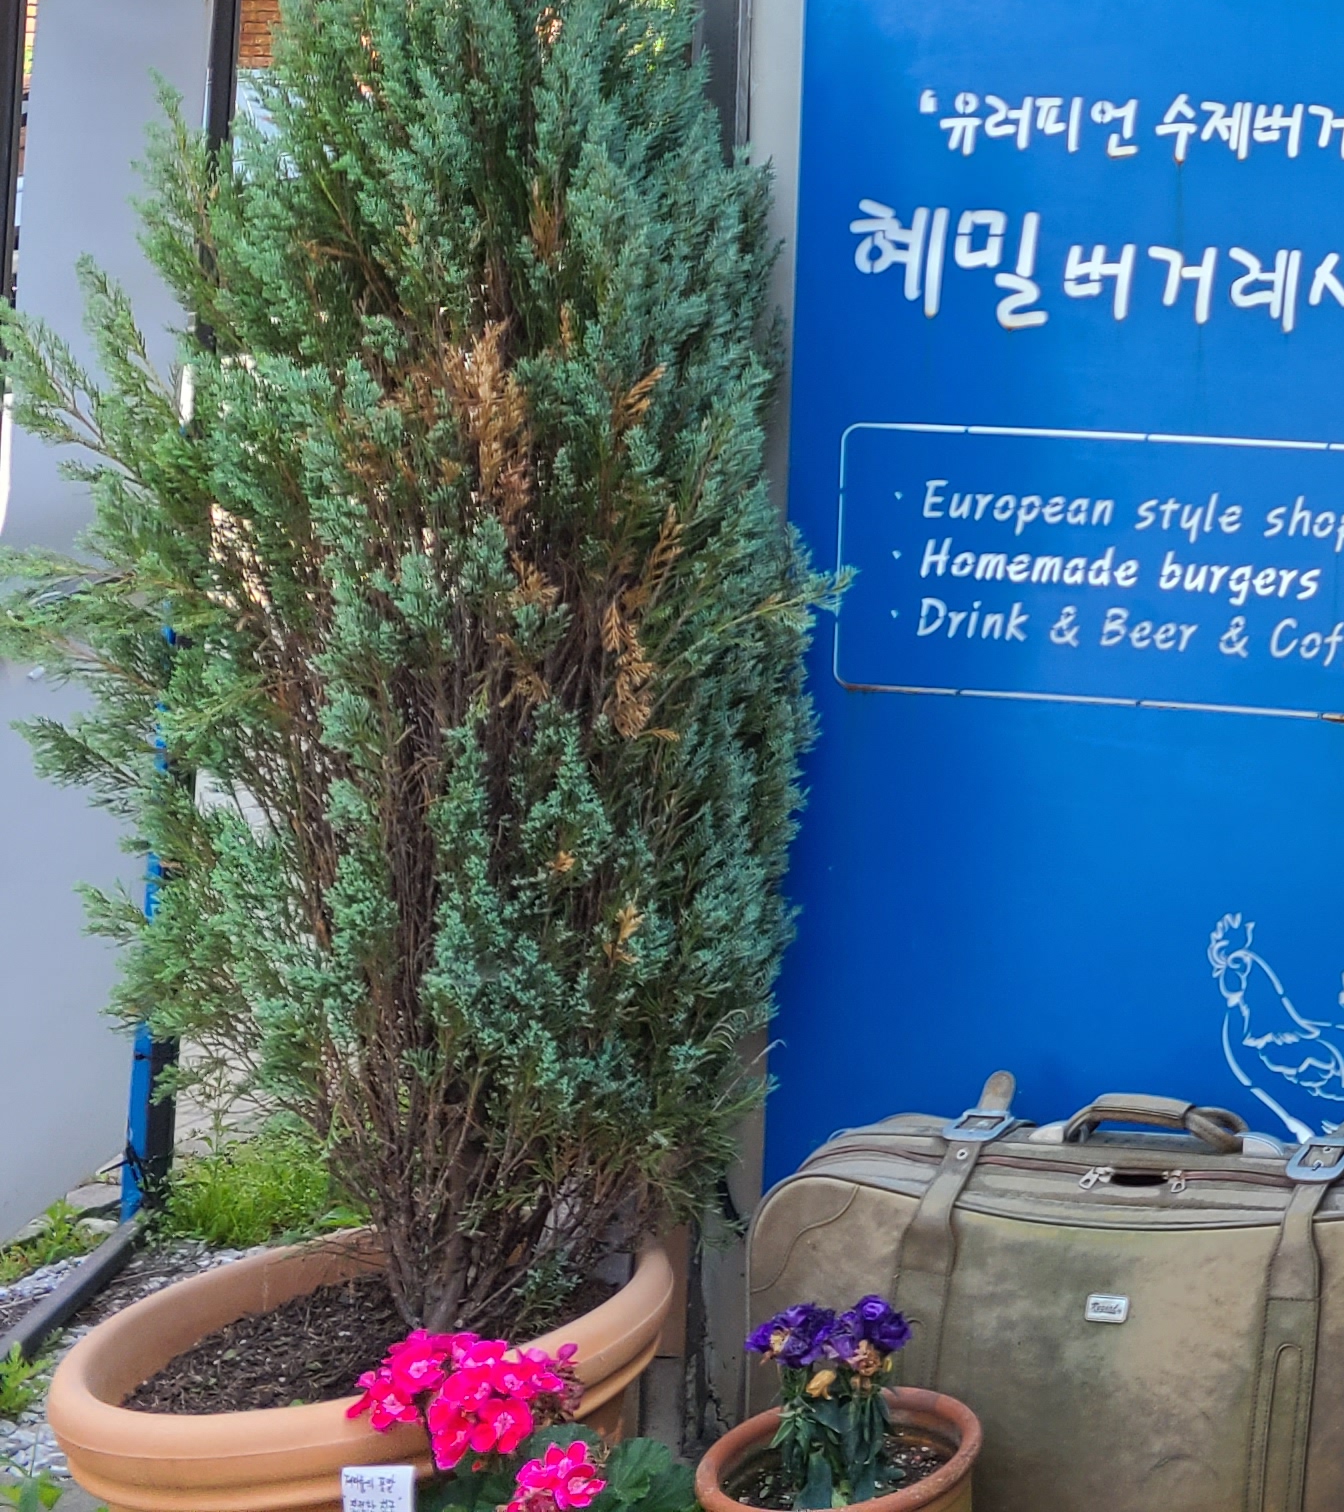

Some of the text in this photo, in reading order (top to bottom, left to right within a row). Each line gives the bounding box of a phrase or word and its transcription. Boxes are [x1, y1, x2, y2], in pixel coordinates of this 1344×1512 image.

[922, 480, 1114, 535] European
[1135, 492, 1243, 545] style
[920, 538, 1321, 606] Homemade burgers
[915, 597, 1029, 643] Drink
[1050, 606, 1080, 648] &
[1100, 607, 1199, 653] Beer
[1219, 614, 1249, 659] &
